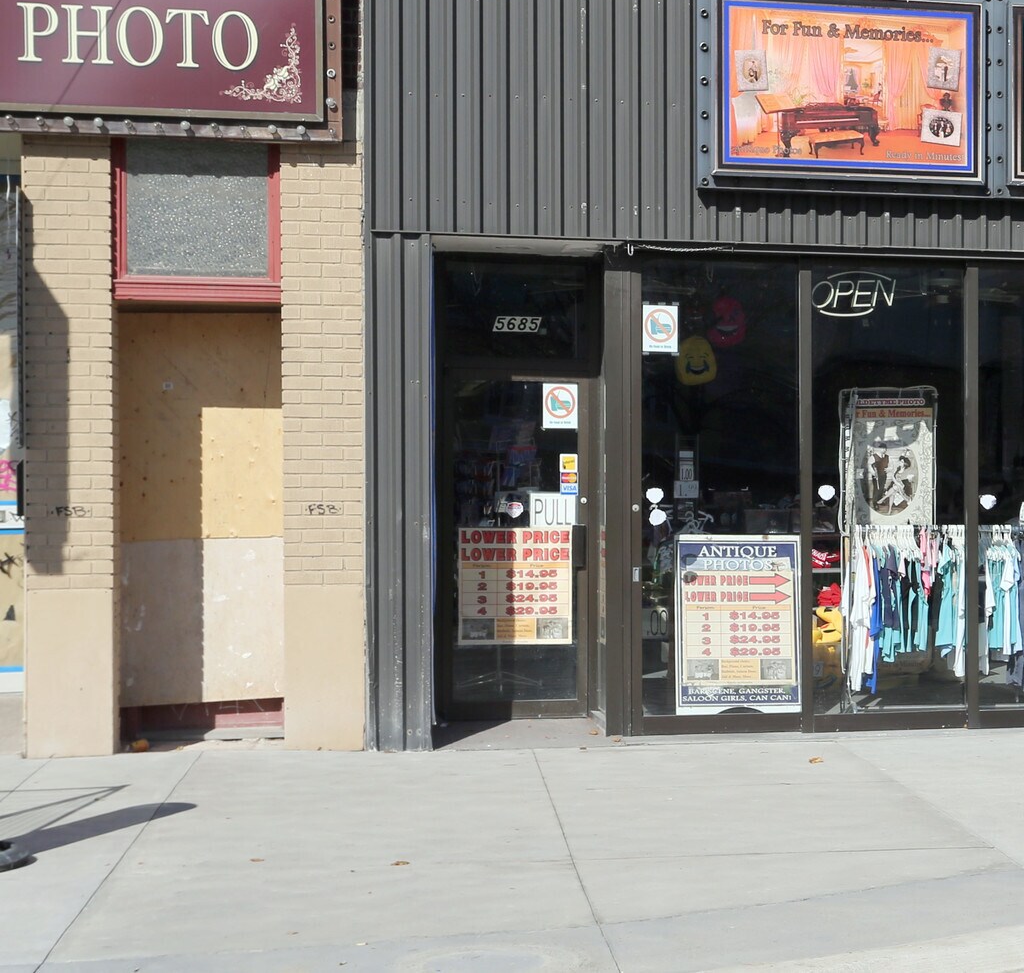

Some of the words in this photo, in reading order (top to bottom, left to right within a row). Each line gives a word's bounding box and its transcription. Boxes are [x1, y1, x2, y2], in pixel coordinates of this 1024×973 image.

[16, 1, 259, 72] PHOTO
[761, 19, 787, 36] For
[792, 21, 822, 38] Fun
[827, 23, 840, 38] &
[843, 24, 934, 44] Memories...
[772, 145, 802, 156] Photos
[886, 150, 912, 161] Ready
[915, 152, 923, 160] in
[811, 279, 897, 309] OPEN
[495, 317, 540, 331] 5685
[862, 409, 877, 418] Fun
[534, 498, 572, 526] PULL
[461, 530, 517, 544] LOWER
[522, 530, 570, 544] PRICE
[461, 548, 517, 561] LOWER
[522, 548, 570, 561] PRICE
[698, 545, 777, 559] ANTIQUE
[704, 560, 774, 572] PHOTOS
[478, 570, 486, 580] 1
[506, 568, 558, 580] $14.95
[477, 582, 487, 591] 2
[506, 581, 558, 591] $19.95
[684, 575, 717, 587] LOWER
[720, 575, 749, 587] PRICE
[477, 595, 487, 604] 3
[506, 593, 558, 603] $24.95
[684, 591, 717, 603] LOWER
[720, 591, 749, 603] PRICE
[477, 607, 487, 616] 4
[505, 606, 558, 616] $29.95
[702, 612, 709, 621] 1
[729, 610, 780, 621] $14.95
[701, 624, 711, 632] 2
[729, 622, 780, 632] $19.95
[701, 637, 711, 645] 3
[729, 634, 780, 644] $24.95
[701, 648, 711, 656] 4
[730, 646, 781, 657] $29.95
